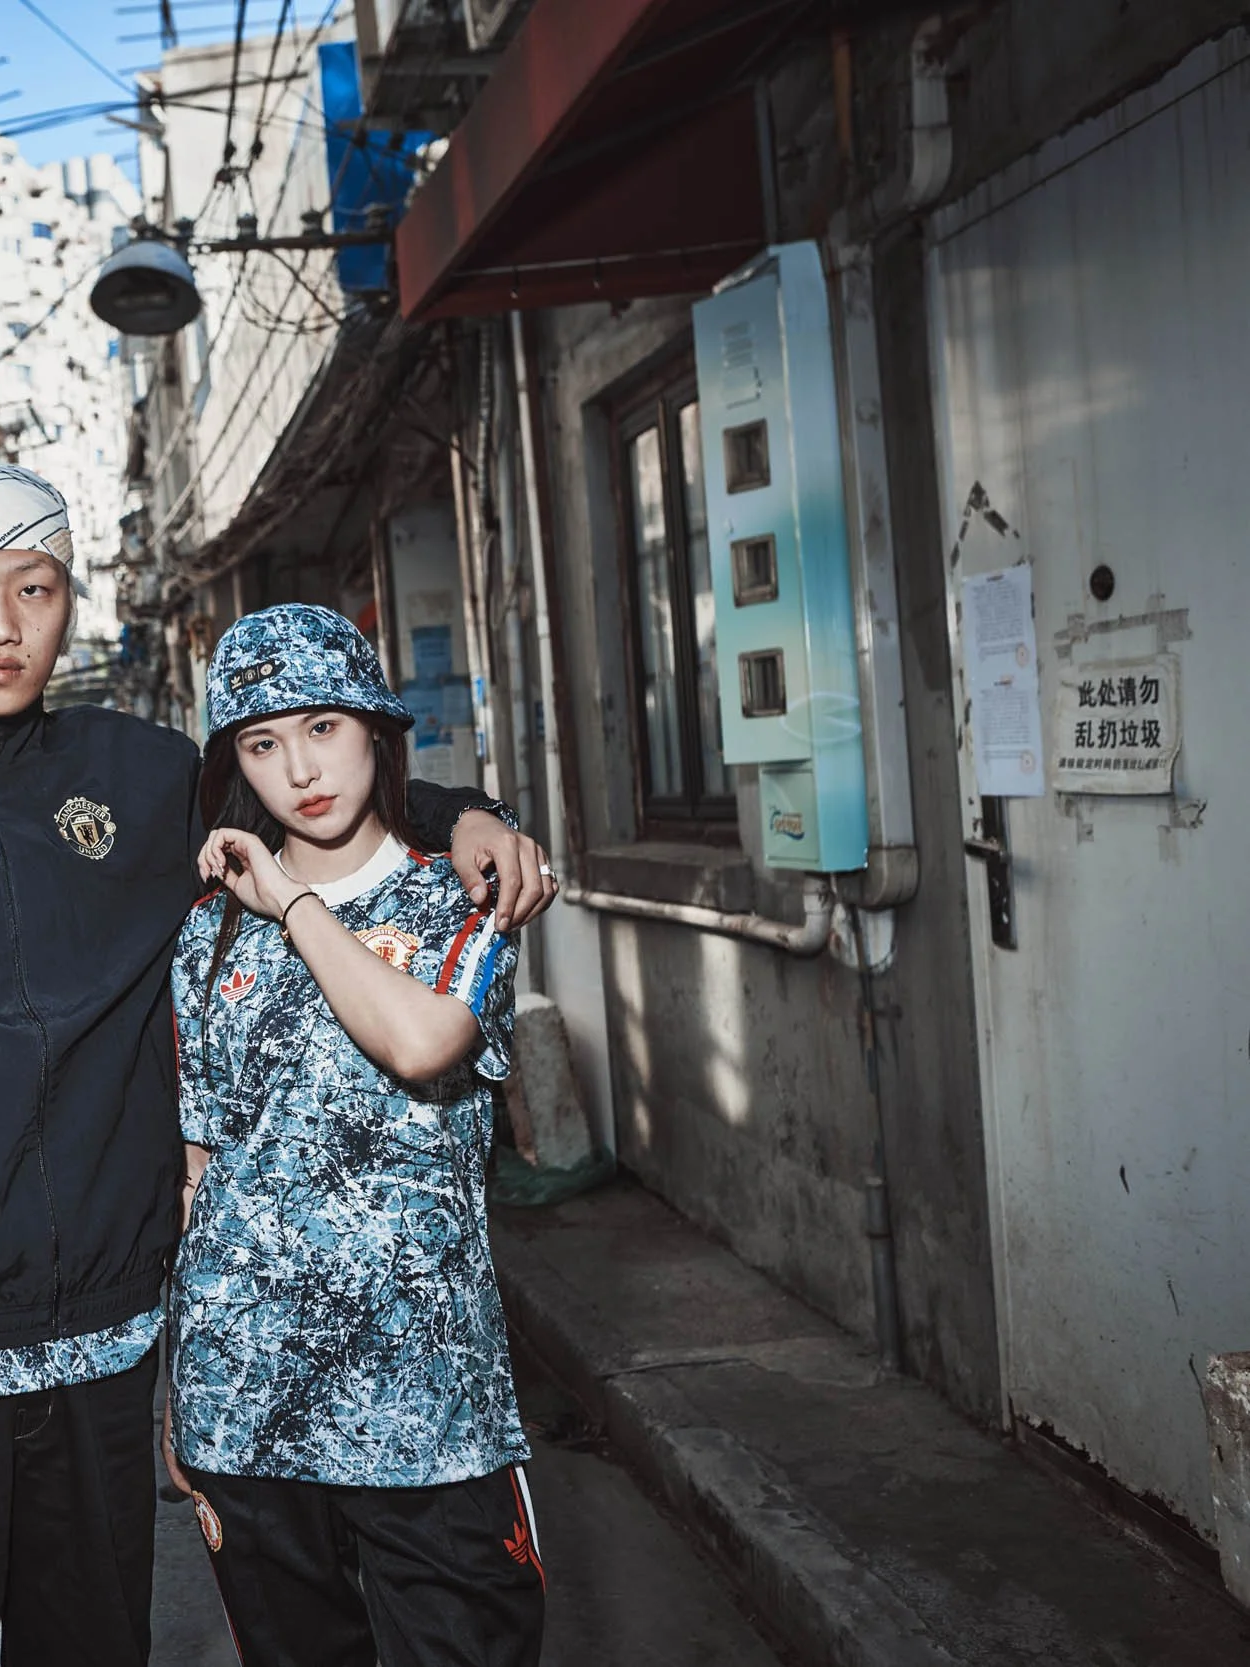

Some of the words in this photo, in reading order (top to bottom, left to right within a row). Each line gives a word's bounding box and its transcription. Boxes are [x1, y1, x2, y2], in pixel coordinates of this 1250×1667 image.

[1077, 675, 1160, 708] 此处请勿
[1074, 719, 1162, 749] 乱扔垃圾
[59, 801, 107, 825] MANCHESTER
[78, 843, 108, 856] UNITED
